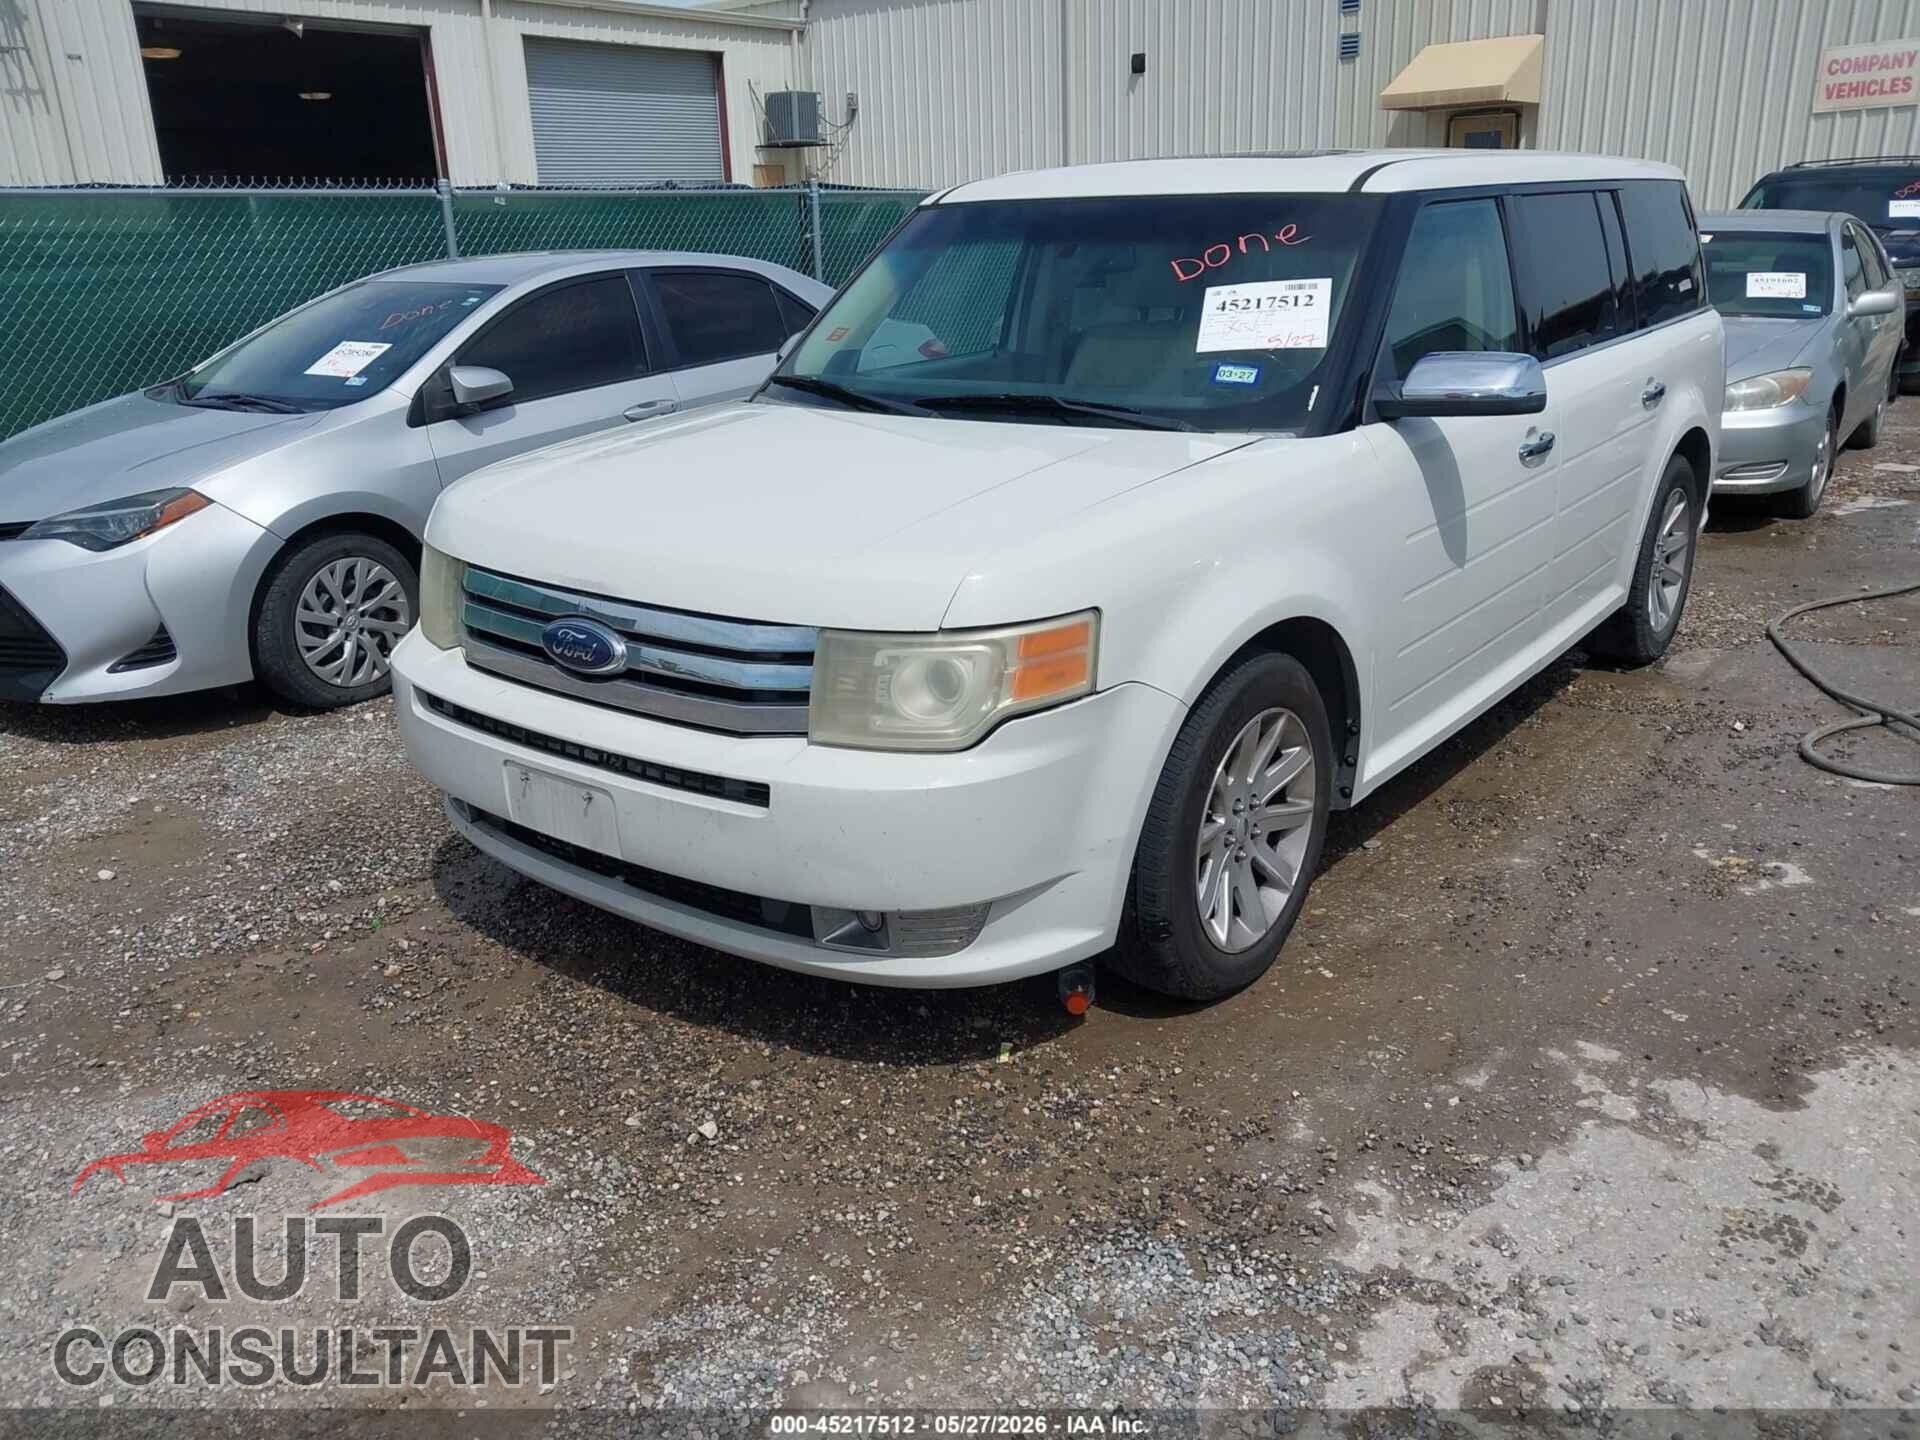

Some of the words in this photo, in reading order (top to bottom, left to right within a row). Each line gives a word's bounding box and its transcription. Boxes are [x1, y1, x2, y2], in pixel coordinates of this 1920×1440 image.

[1827, 51, 1918, 76] COMPANY
[1825, 76, 1913, 100] VEHICLES
[1216, 294, 1314, 312] 45217512
[552, 629, 597, 662] Ford
